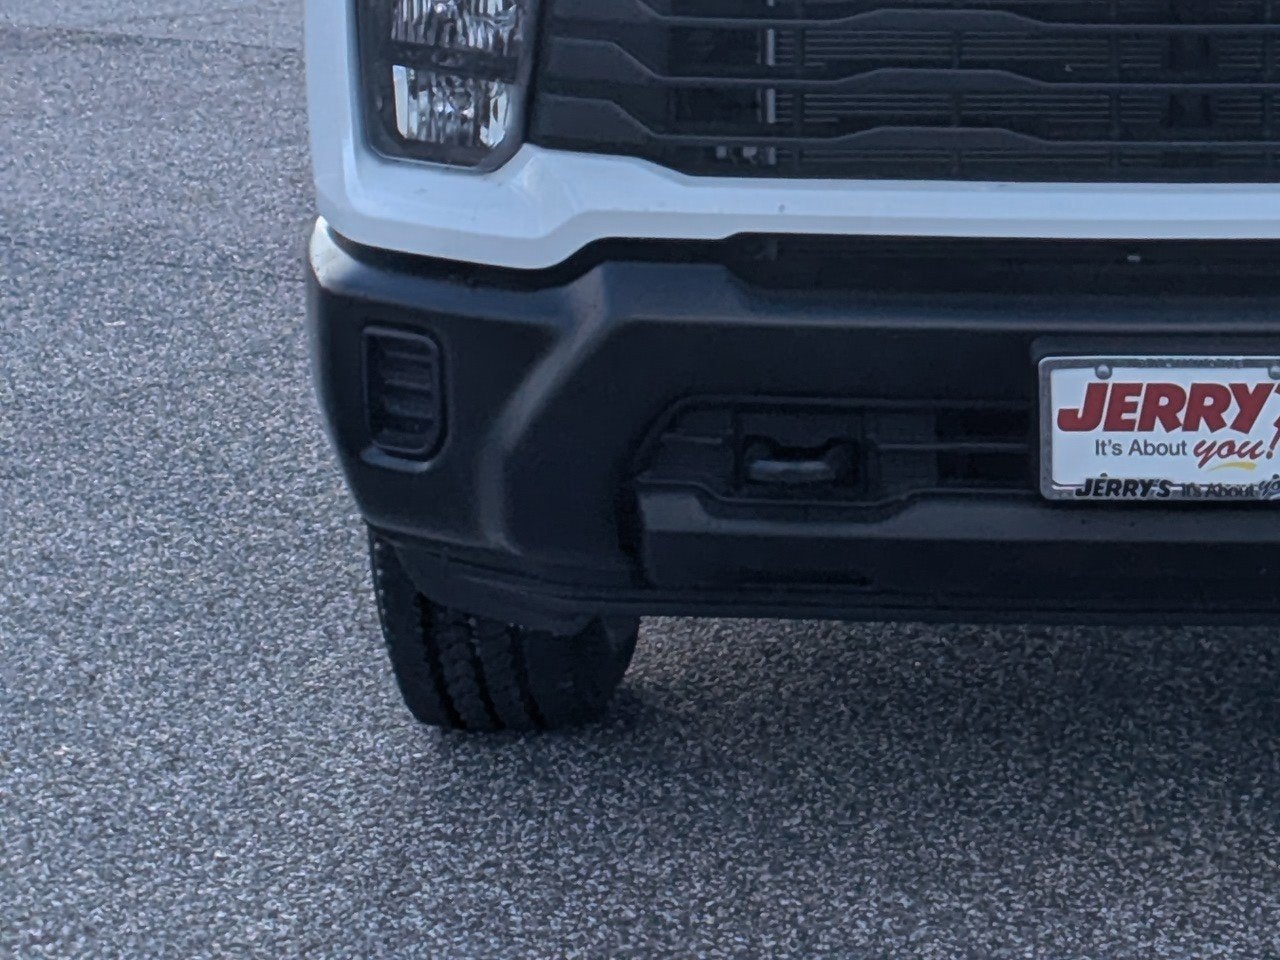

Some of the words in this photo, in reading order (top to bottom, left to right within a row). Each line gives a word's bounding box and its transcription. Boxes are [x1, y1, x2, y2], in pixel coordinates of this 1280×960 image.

[1095, 439, 1122, 456] It's
[1128, 439, 1187, 456] About
[1075, 478, 1173, 497] JERRY'S
[1205, 483, 1254, 497] About
